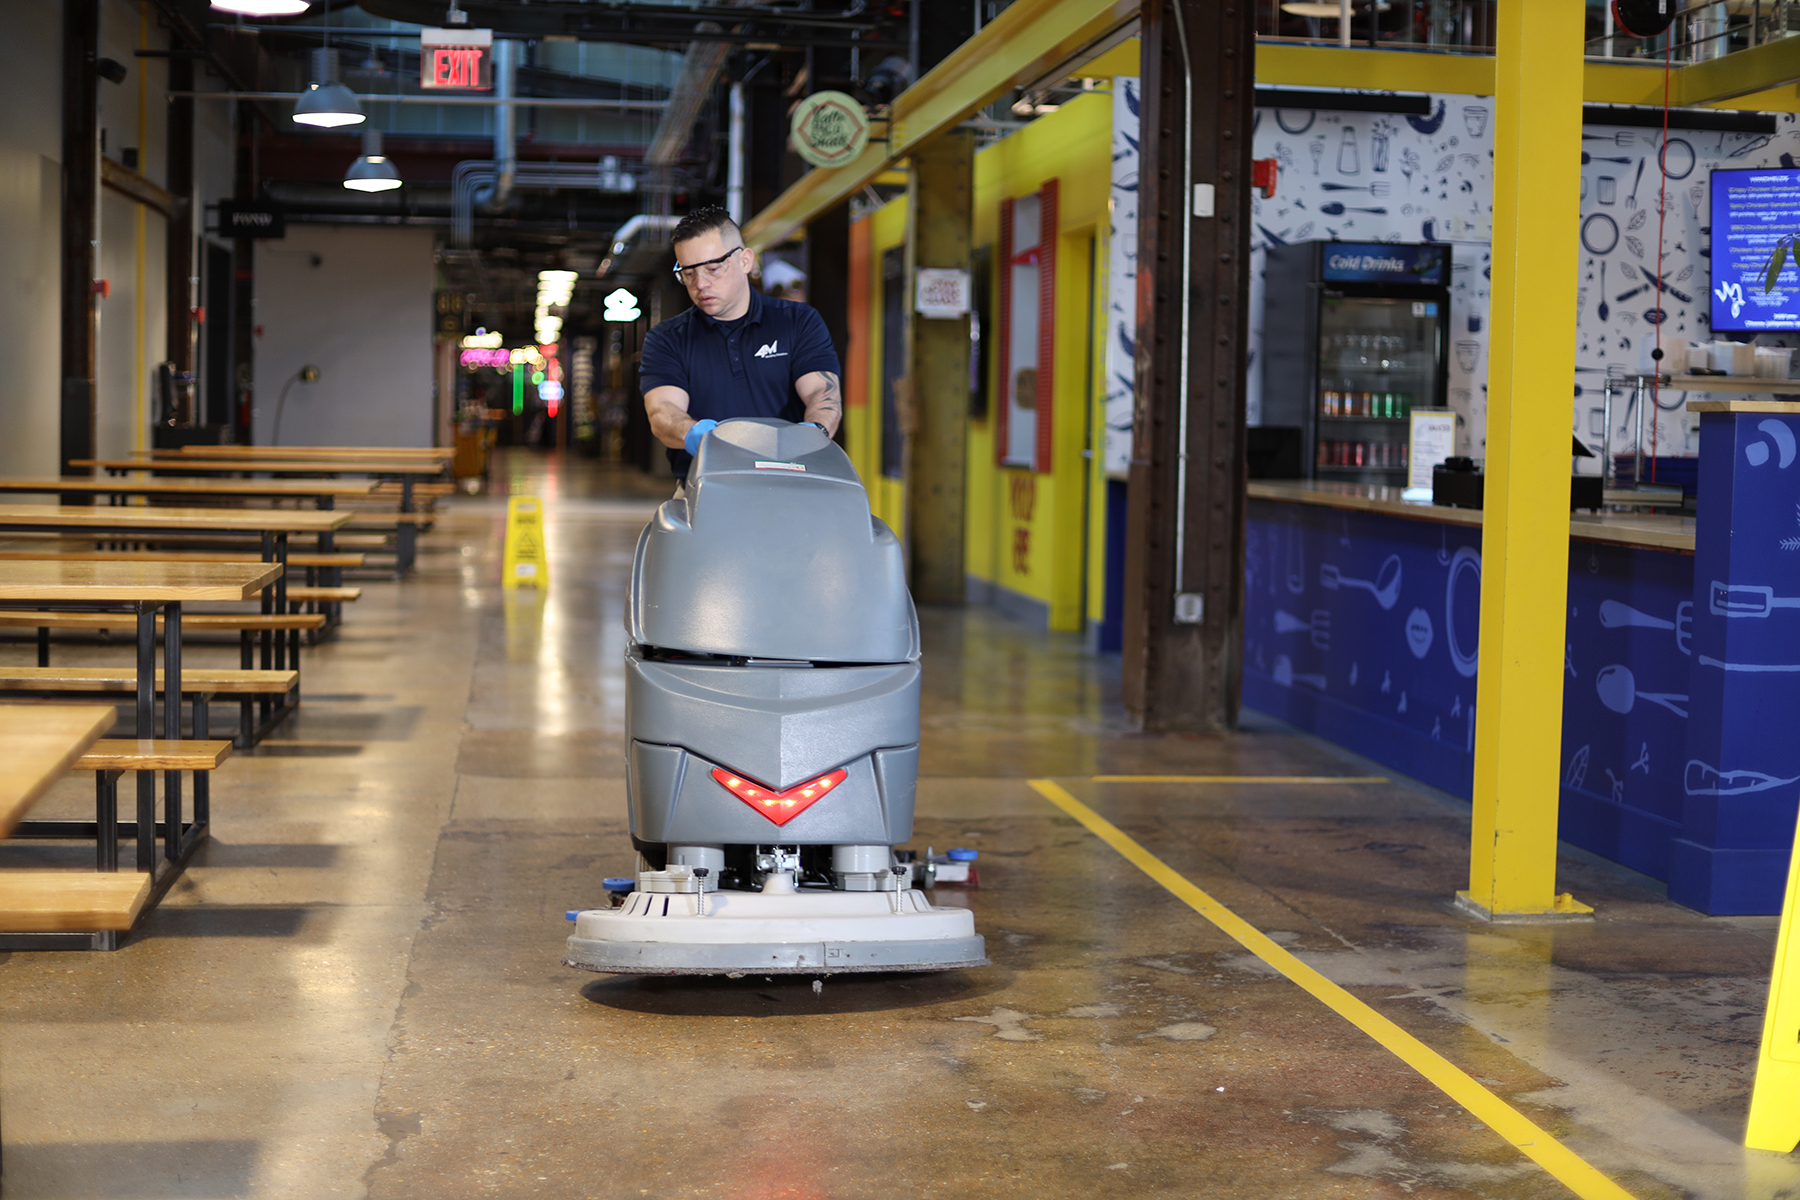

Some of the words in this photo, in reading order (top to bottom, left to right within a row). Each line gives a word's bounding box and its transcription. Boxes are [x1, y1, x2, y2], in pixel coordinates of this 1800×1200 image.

[434, 49, 483, 87] EXIT
[1329, 254, 1361, 271] Cold
[1361, 255, 1405, 272] Drinks
